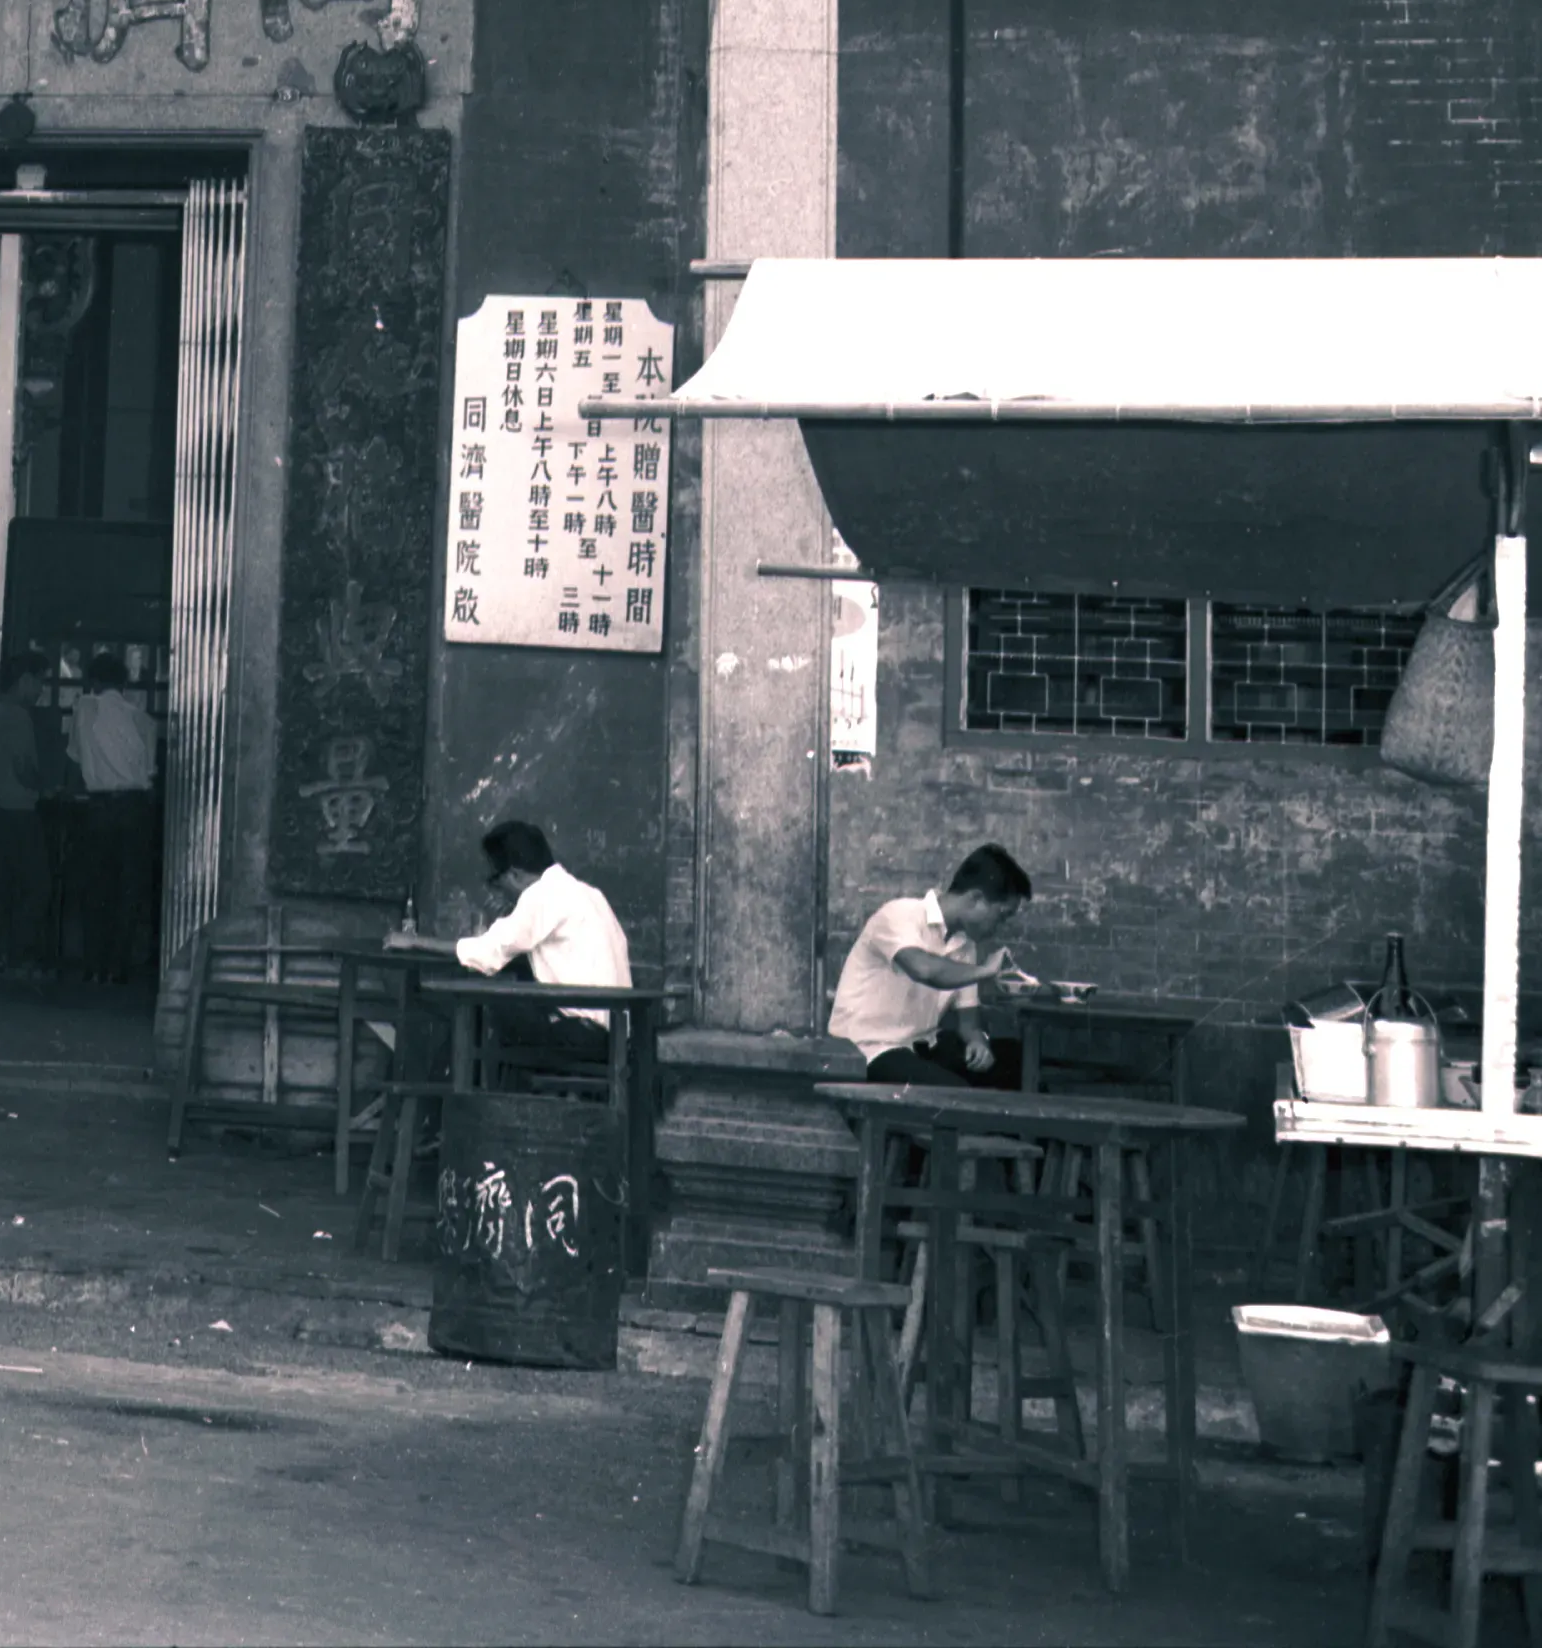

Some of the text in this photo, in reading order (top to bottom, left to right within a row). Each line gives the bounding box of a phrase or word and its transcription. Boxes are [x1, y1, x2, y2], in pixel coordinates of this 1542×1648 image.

[500, 310, 526, 433] 星期日休息
